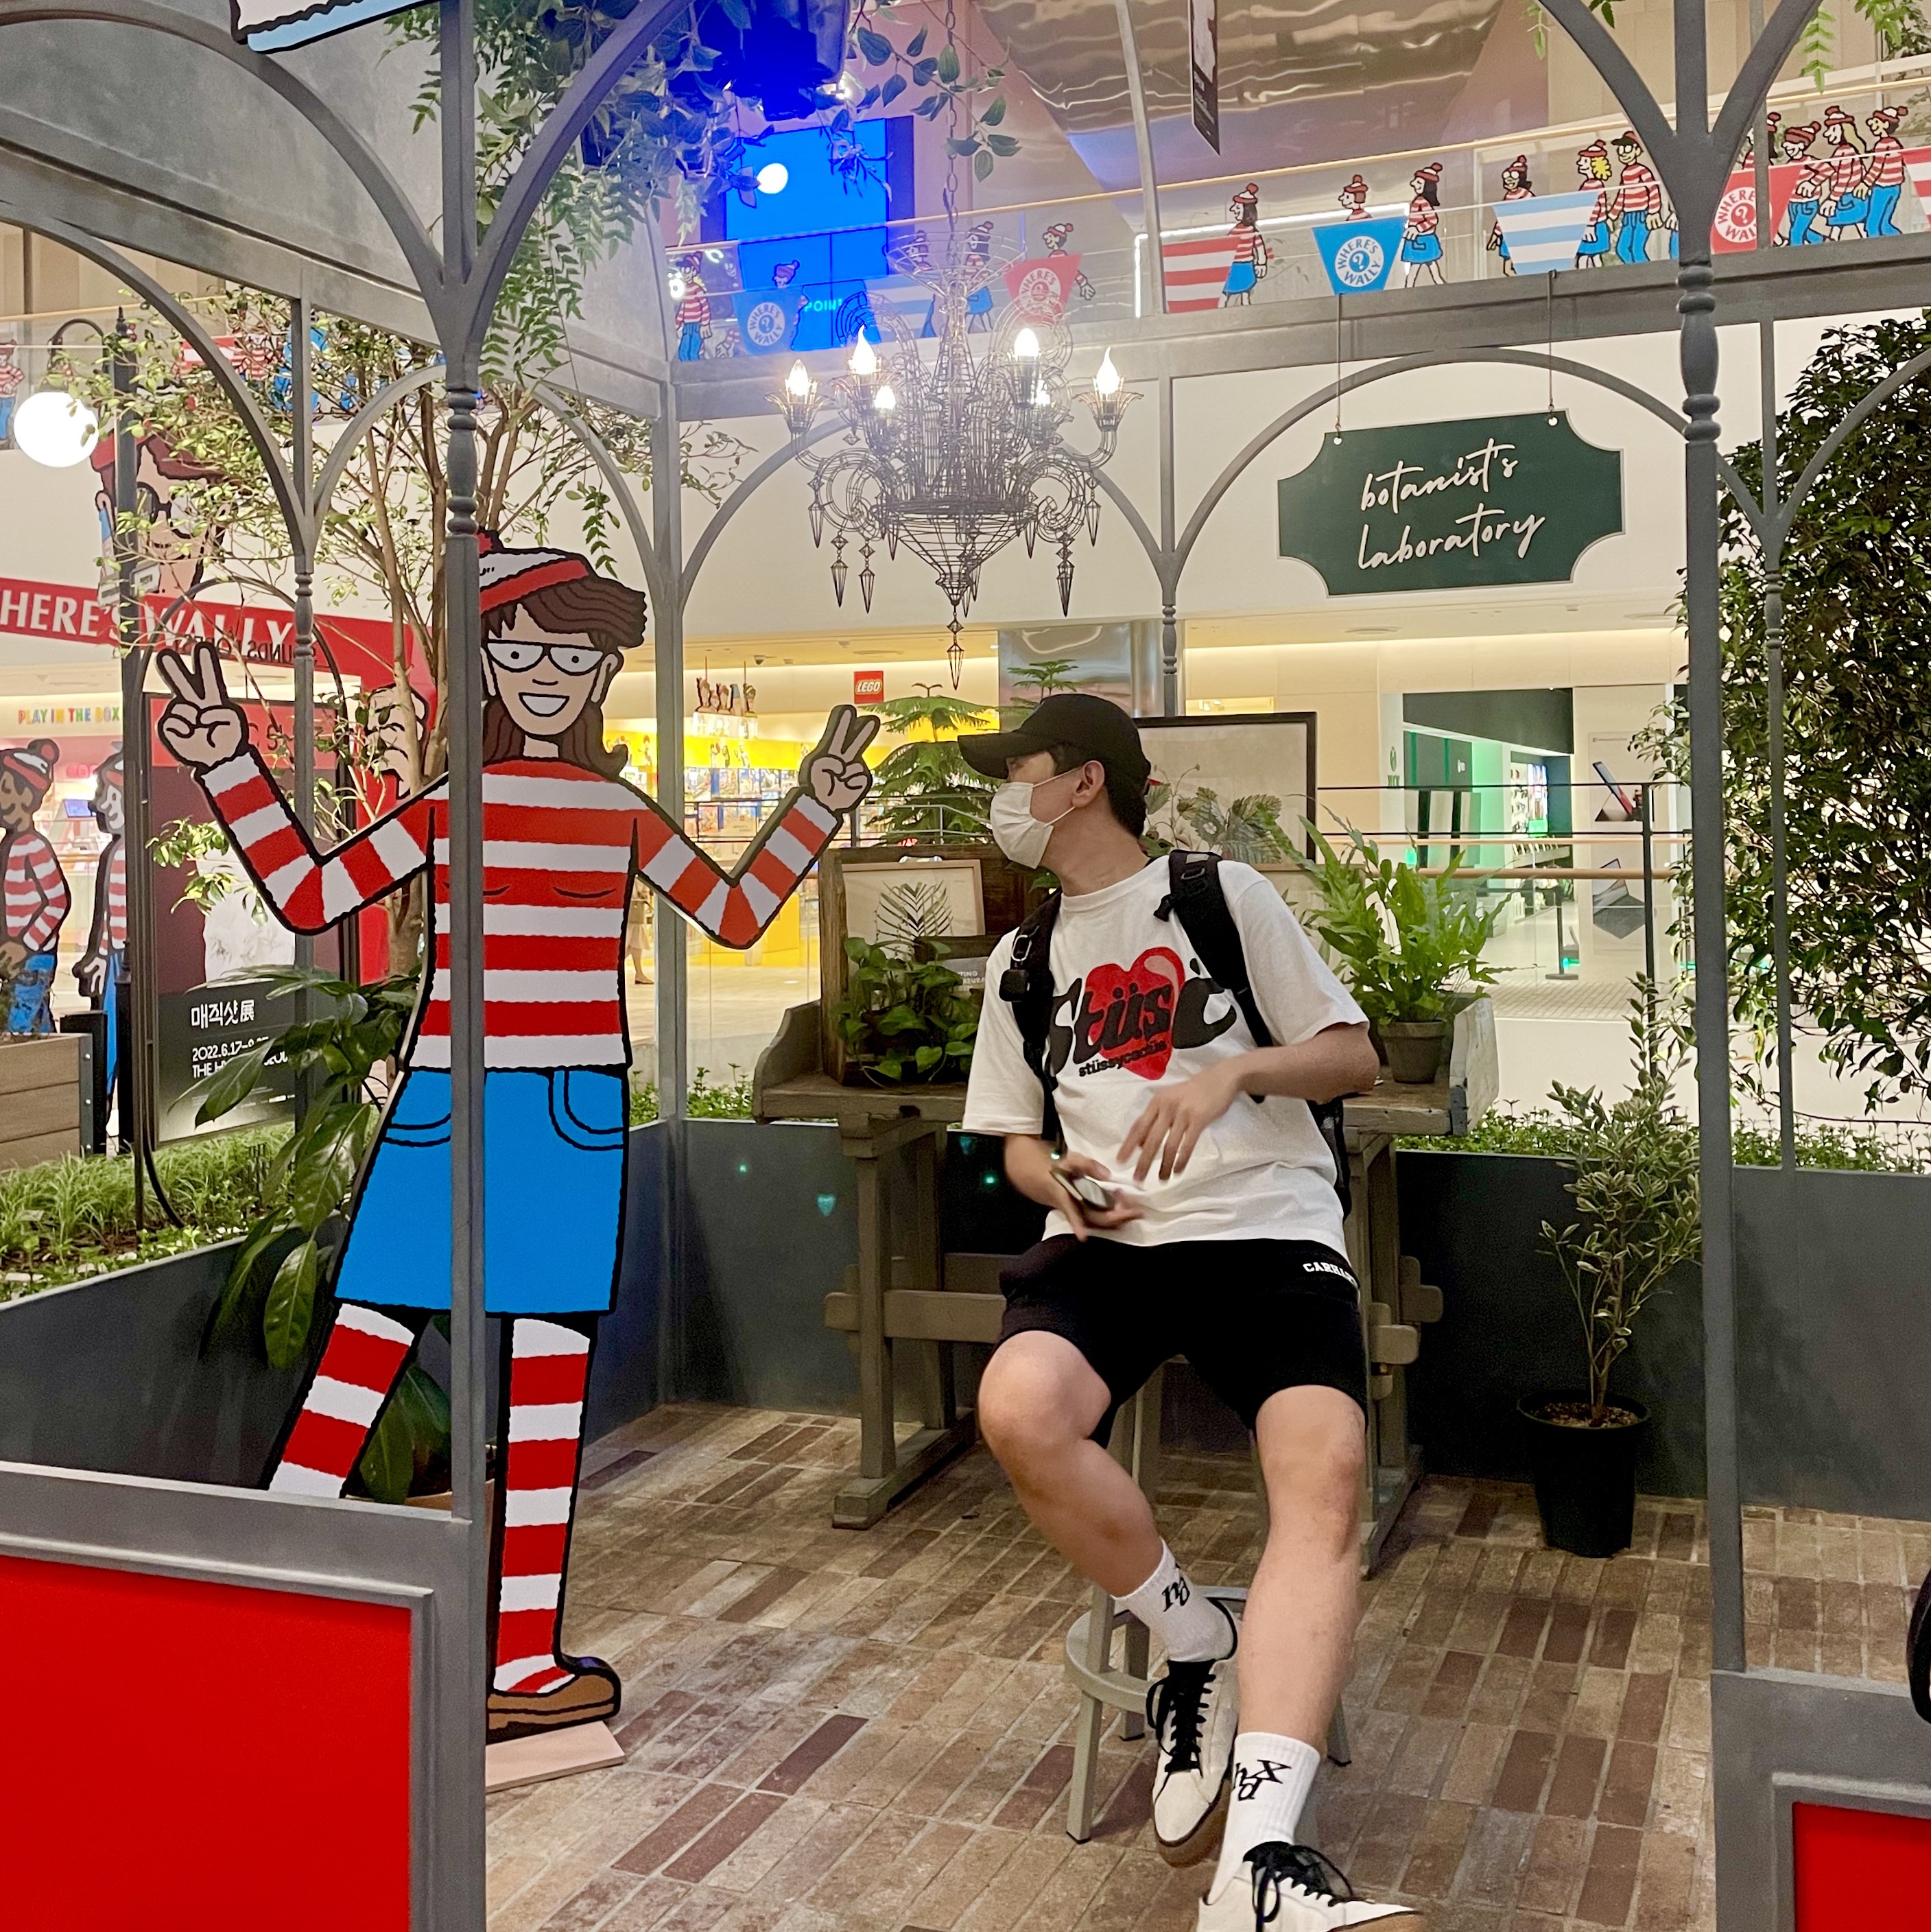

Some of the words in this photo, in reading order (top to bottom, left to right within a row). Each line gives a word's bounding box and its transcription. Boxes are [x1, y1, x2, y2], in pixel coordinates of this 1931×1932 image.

[1337, 238, 1378, 270] WHERE'S
[1344, 260, 1381, 285] WALLY
[755, 325, 783, 344] WALLY
[1360, 438, 1519, 514] botanist's
[1358, 502, 1546, 570] laboratory
[857, 681, 881, 693] LEGO
[18, 709, 48, 725] PLAY
[50, 709, 64, 724] IN
[68, 707, 91, 722] THE
[95, 706, 120, 722] BOX
[191, 999, 254, 1029] 매직샷展
[191, 1063, 214, 1079] THE
